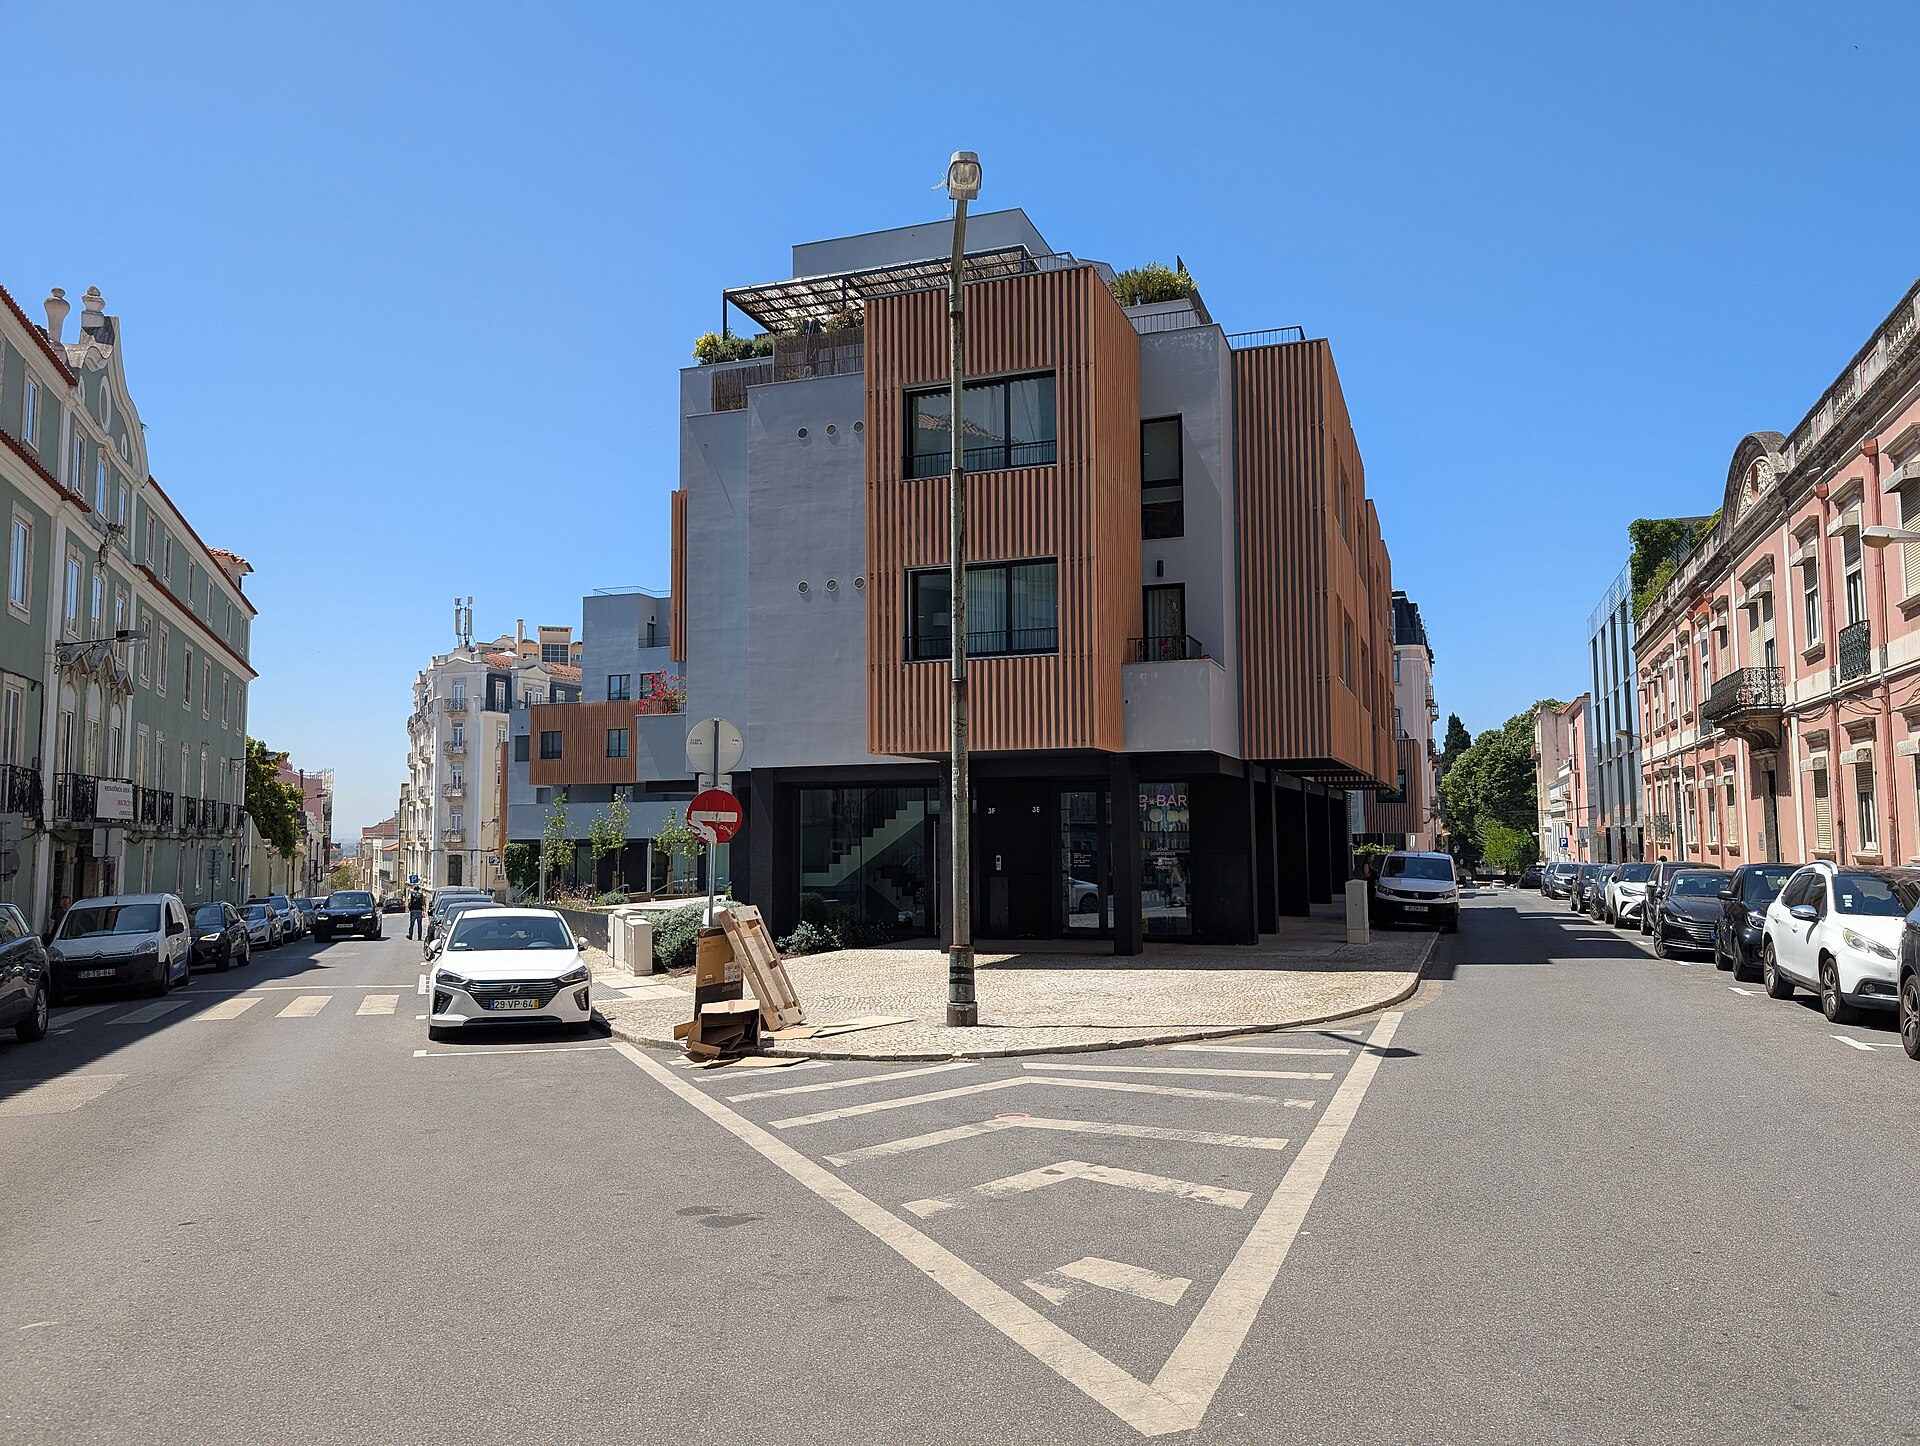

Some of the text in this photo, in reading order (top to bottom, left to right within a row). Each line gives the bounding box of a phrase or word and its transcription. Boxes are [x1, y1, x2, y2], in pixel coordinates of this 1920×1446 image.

[1156, 794, 1188, 807] BAR
[987, 807, 996, 815] 3F
[1560, 838, 1567, 847] P
